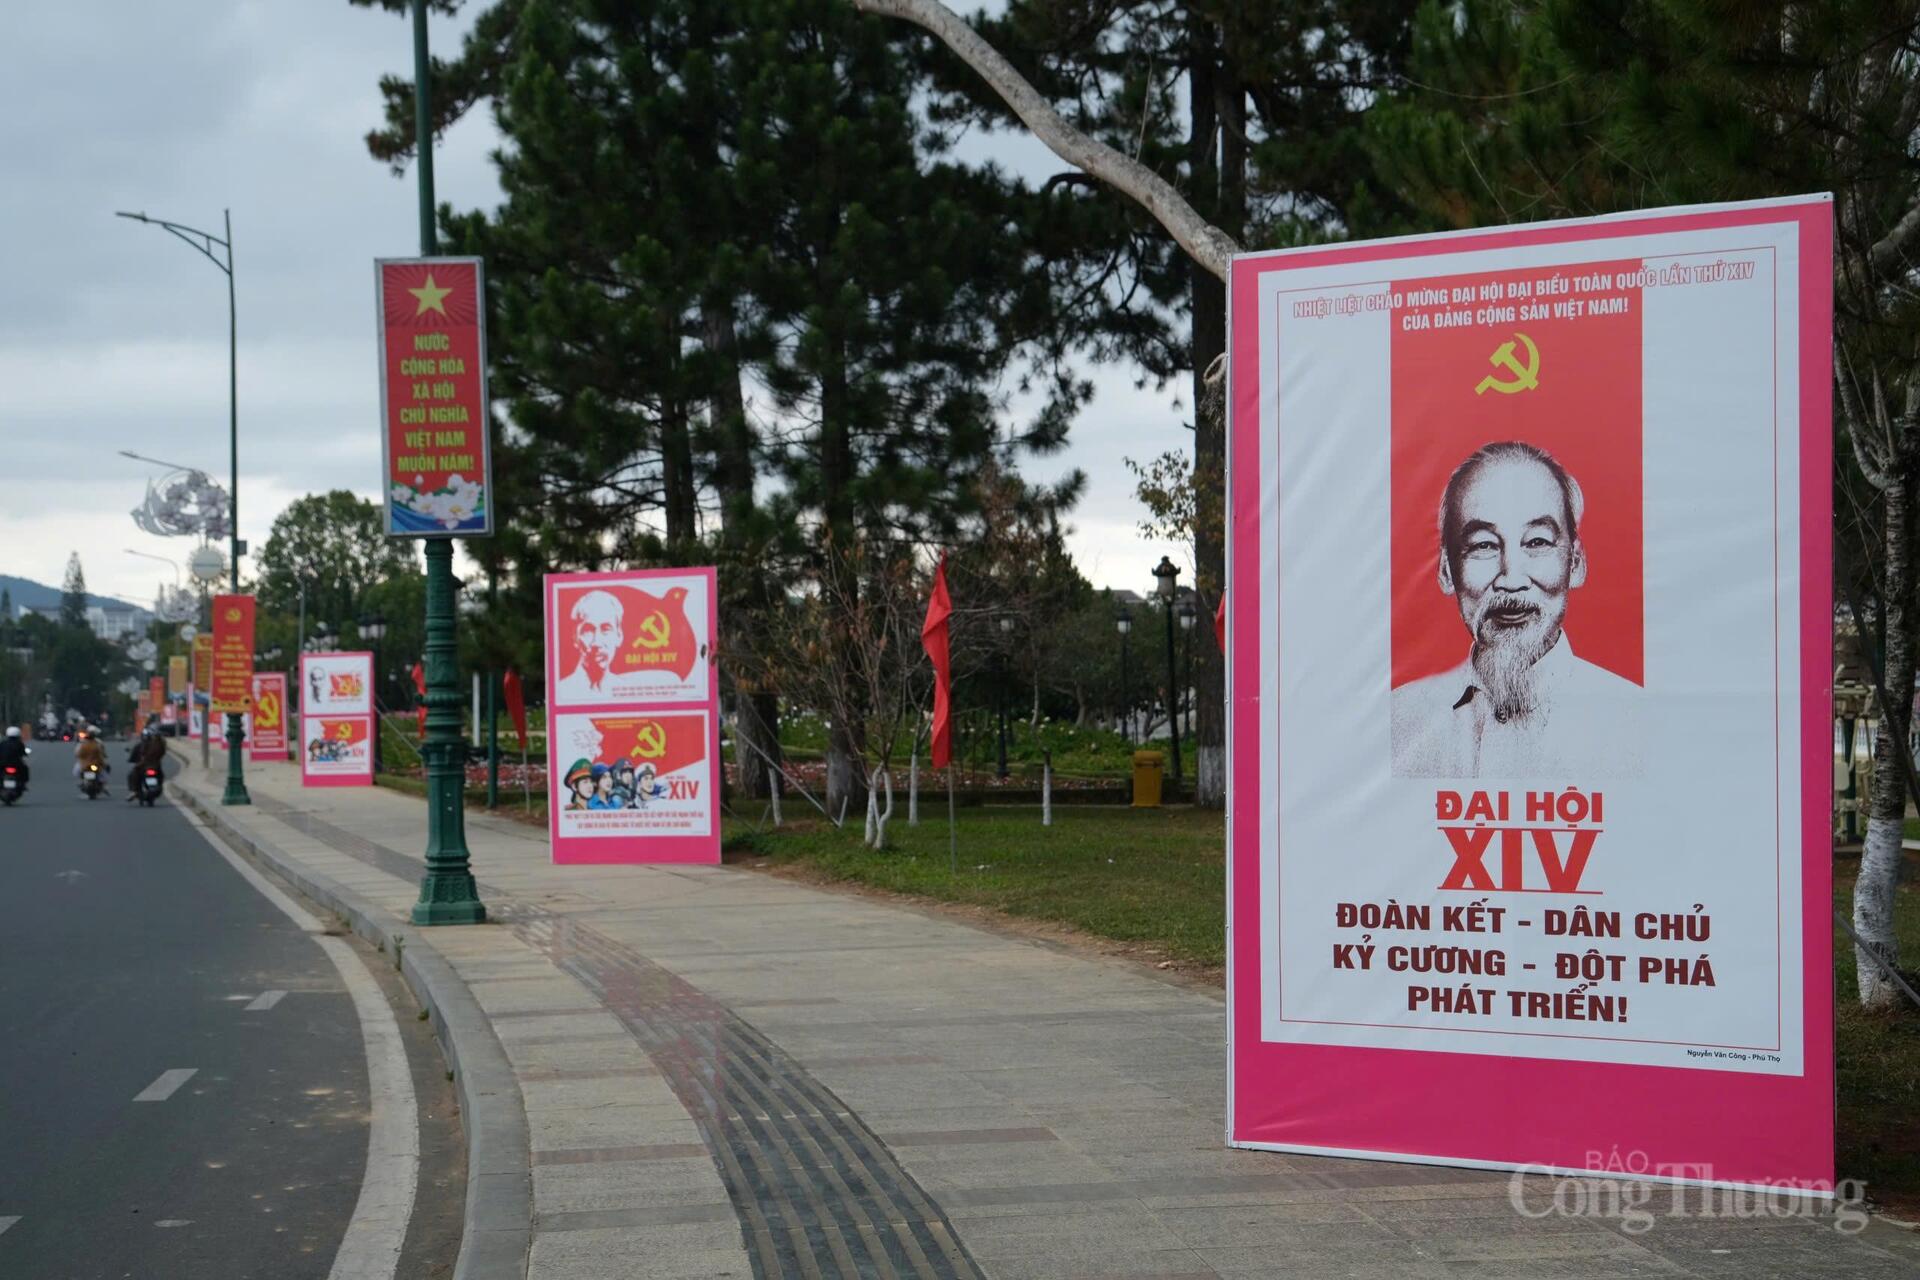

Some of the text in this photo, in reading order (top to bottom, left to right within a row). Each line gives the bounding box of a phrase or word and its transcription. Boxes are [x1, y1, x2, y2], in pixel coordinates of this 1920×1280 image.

[1293, 297, 1333, 319] NHIỆT
[1335, 294, 1363, 316] LIỆT
[1366, 289, 1402, 311] CHÀO
[1407, 286, 1448, 307] MỪNG
[1452, 286, 1476, 305] ĐẠI
[1480, 281, 1503, 302] HỘI
[1508, 281, 1532, 302] ĐẠI
[1573, 272, 1611, 292] TOÀN
[1616, 265, 1657, 291] QUỐC
[1728, 261, 1755, 281] XIV
[1402, 297, 1628, 331] CỦA ĐẢNG CỘNG SẢN VIỆT NAM!
[401, 356, 436, 379] CỘNG
[405, 428, 465, 450] VIỆT NAM
[668, 780, 700, 800] XIV
[1435, 786, 1603, 828] ĐẠI HỘI
[1437, 827, 1604, 895] XIV
[1336, 898, 1430, 931] ĐOÀN
[1443, 898, 1506, 933] KẾT
[1544, 905, 1621, 938] DÂN
[1634, 903, 1711, 942] CHỦ
[1333, 934, 1376, 970] KỶ
[1387, 944, 1506, 976] CƯƠNG
[1555, 948, 1626, 987] ĐỘT
[1639, 954, 1716, 987] PHÁ
[1408, 983, 1628, 1023] PHÁT TRIỂN!
[1687, 1049, 1712, 1058] Nguyễn
[1728, 1052, 1747, 1061] Công
[1768, 1055, 1781, 1063] Thọ
